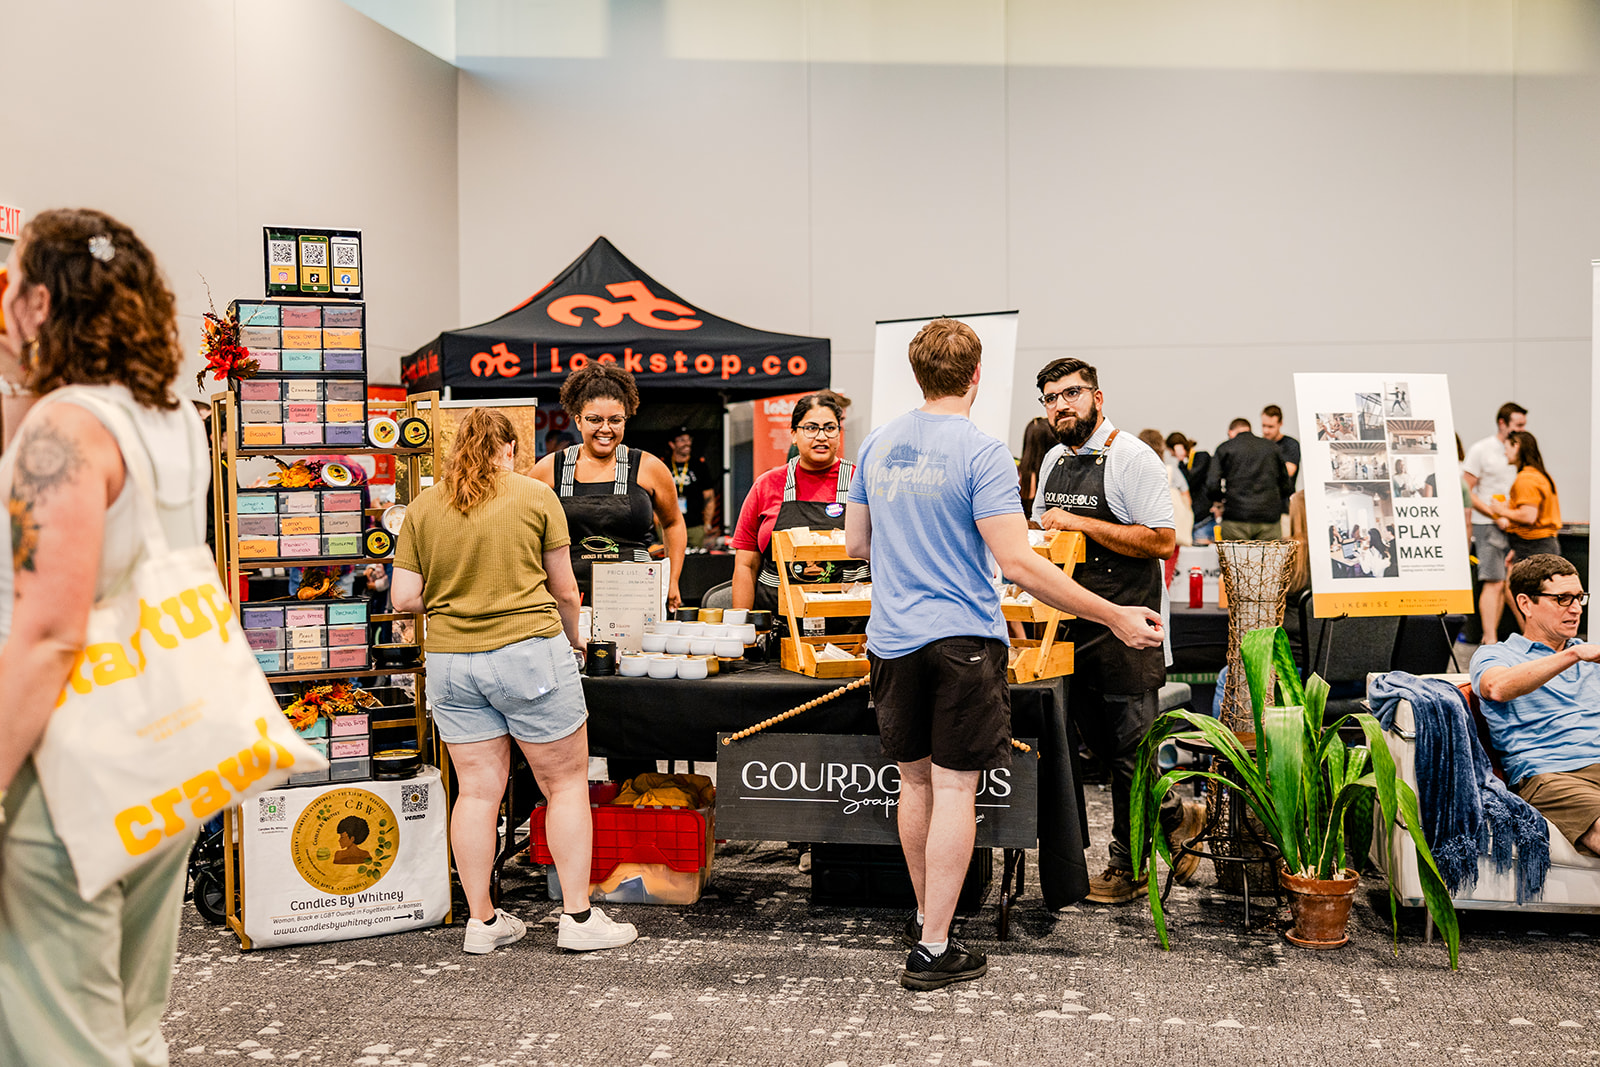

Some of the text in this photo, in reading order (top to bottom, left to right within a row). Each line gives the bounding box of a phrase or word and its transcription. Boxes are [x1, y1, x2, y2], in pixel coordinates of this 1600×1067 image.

[1395, 506, 1439, 518] WORK
[1398, 524, 1441, 539] PLAY
[1400, 546, 1443, 559] MAKE
[114, 717, 295, 856] crawl
[741, 761, 1011, 797] GOURDGS
[290, 890, 404, 911] Candles By Whitney
[297, 914, 313, 922] Black
[336, 909, 356, 917] Owned
[397, 901, 422, 910] Arkansas
[273, 915, 392, 936] www.candlesbywhitney.com
